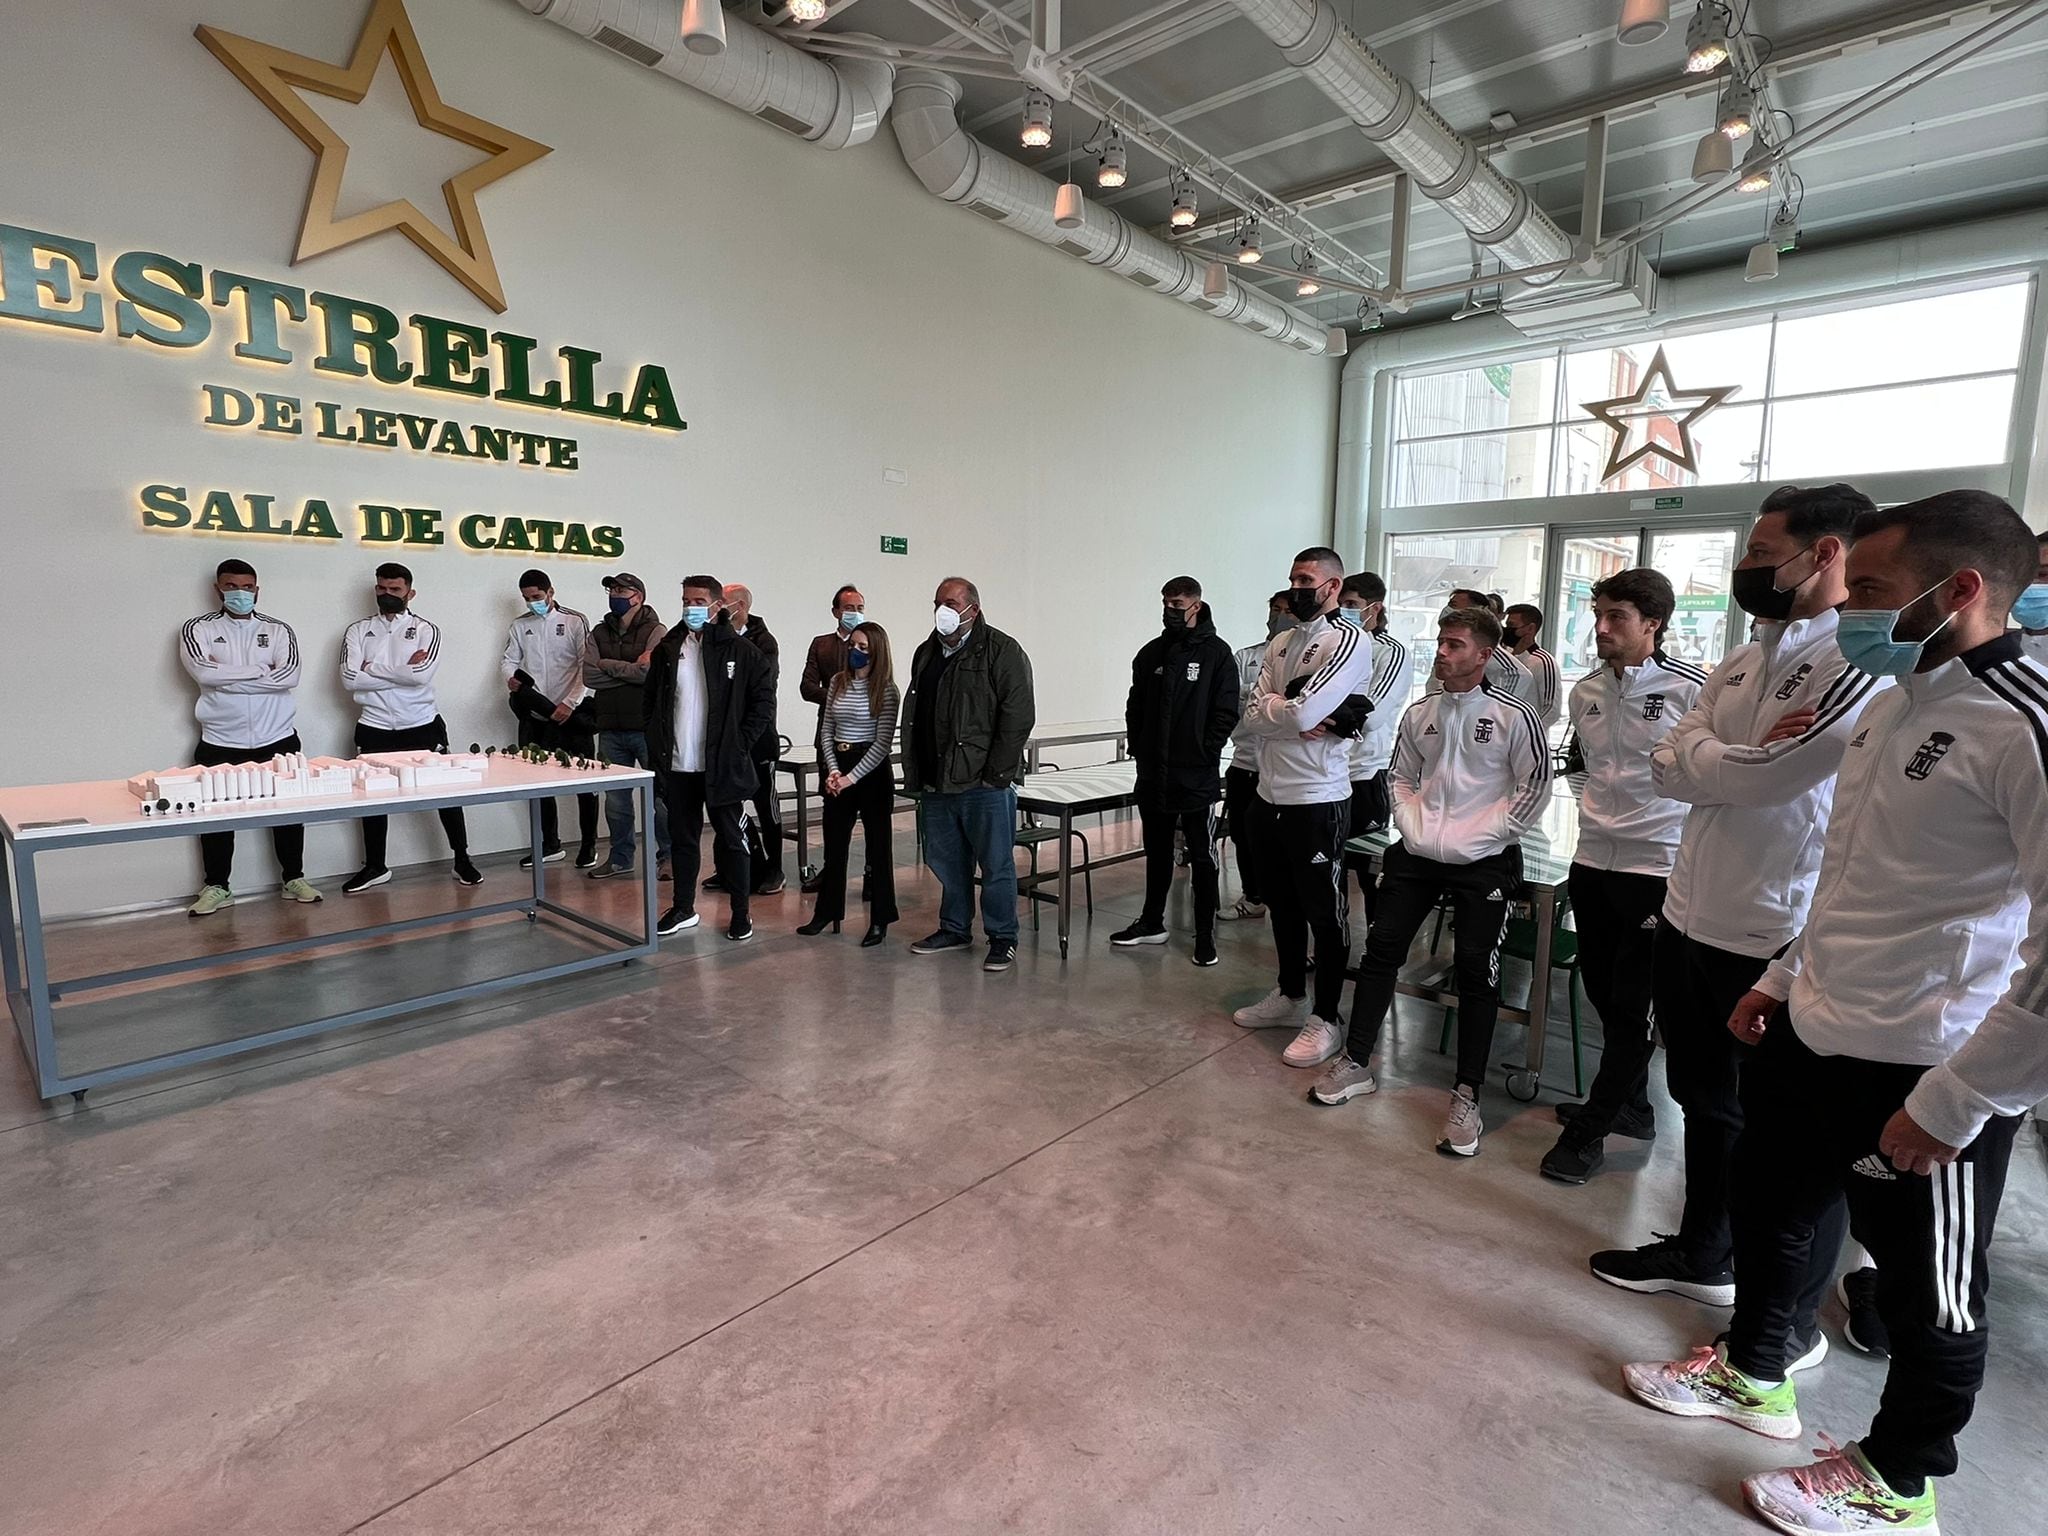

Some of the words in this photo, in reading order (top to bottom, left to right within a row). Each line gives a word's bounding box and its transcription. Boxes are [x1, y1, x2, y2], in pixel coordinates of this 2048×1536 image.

[0, 223, 687, 431] ESTRELLA
[201, 384, 303, 435] DE
[315, 402, 579, 471] LEVANTE
[140, 484, 343, 539] SALA
[359, 504, 445, 546] DE
[459, 516, 625, 558] CATAS
